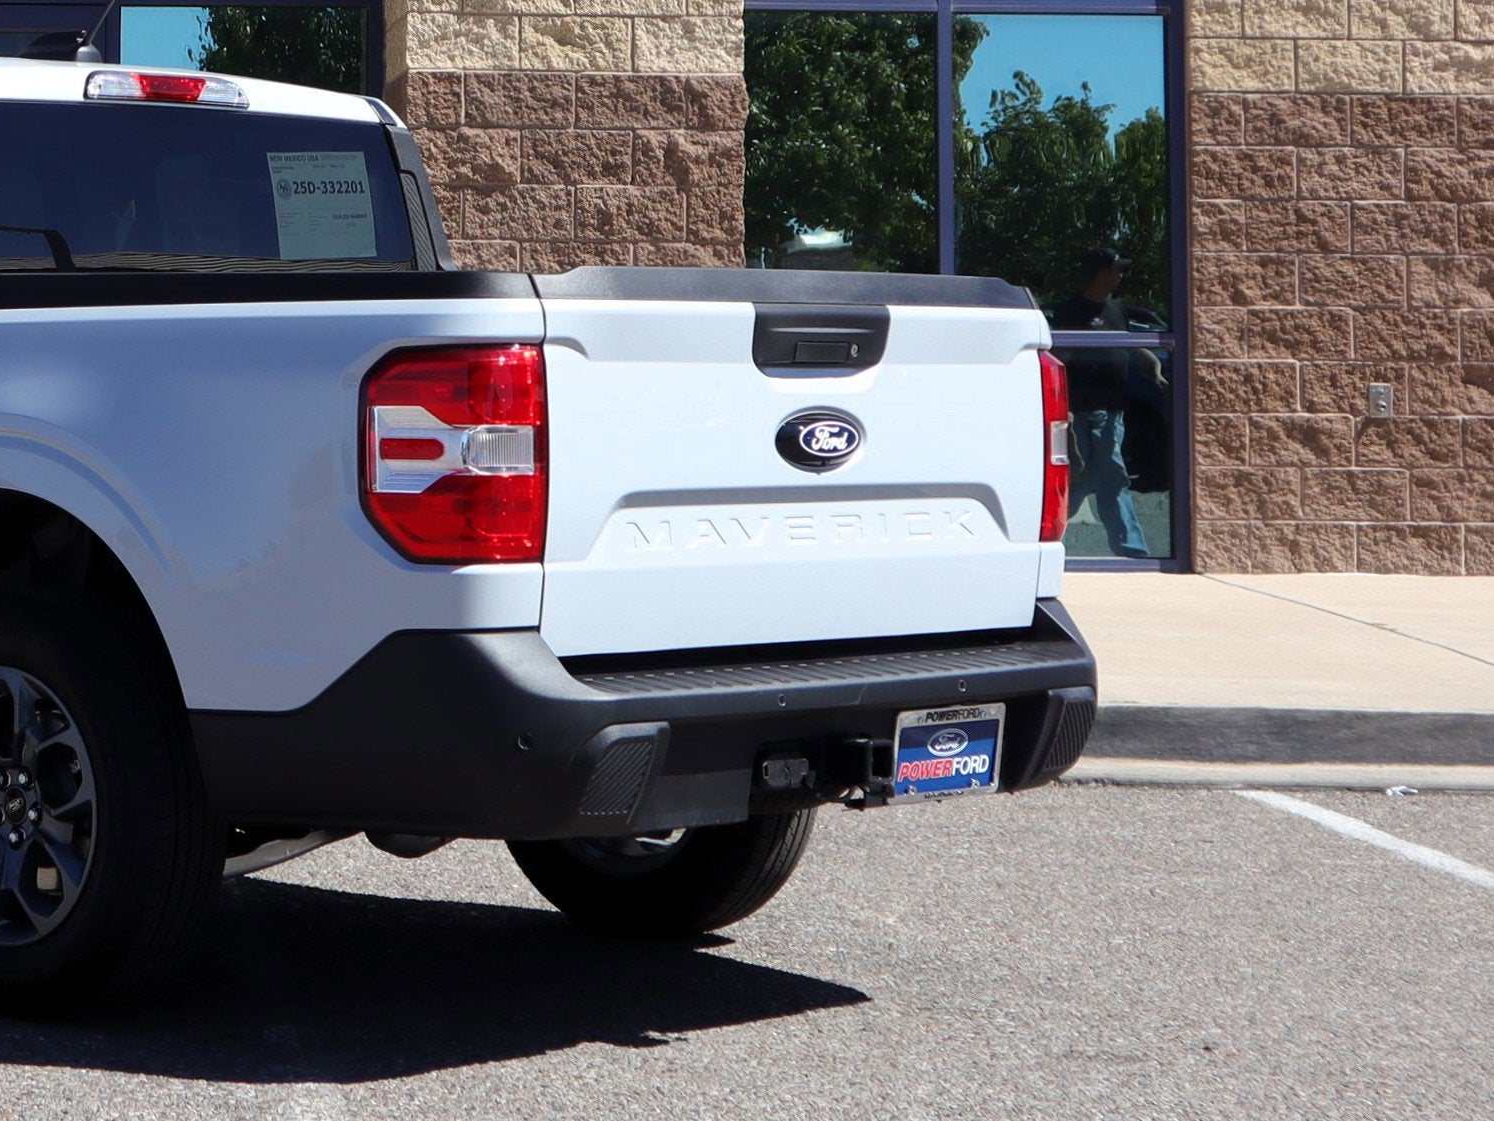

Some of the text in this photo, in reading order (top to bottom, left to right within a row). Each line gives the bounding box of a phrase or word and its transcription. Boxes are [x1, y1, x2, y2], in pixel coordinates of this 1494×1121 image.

[293, 181, 365, 194] 25D-332201
[811, 426, 848, 450] Ford
[624, 511, 977, 550] MAVERICK
[925, 708, 980, 722] POWERFORD
[934, 733, 961, 750] Ford
[898, 755, 989, 782] POWERFORD
